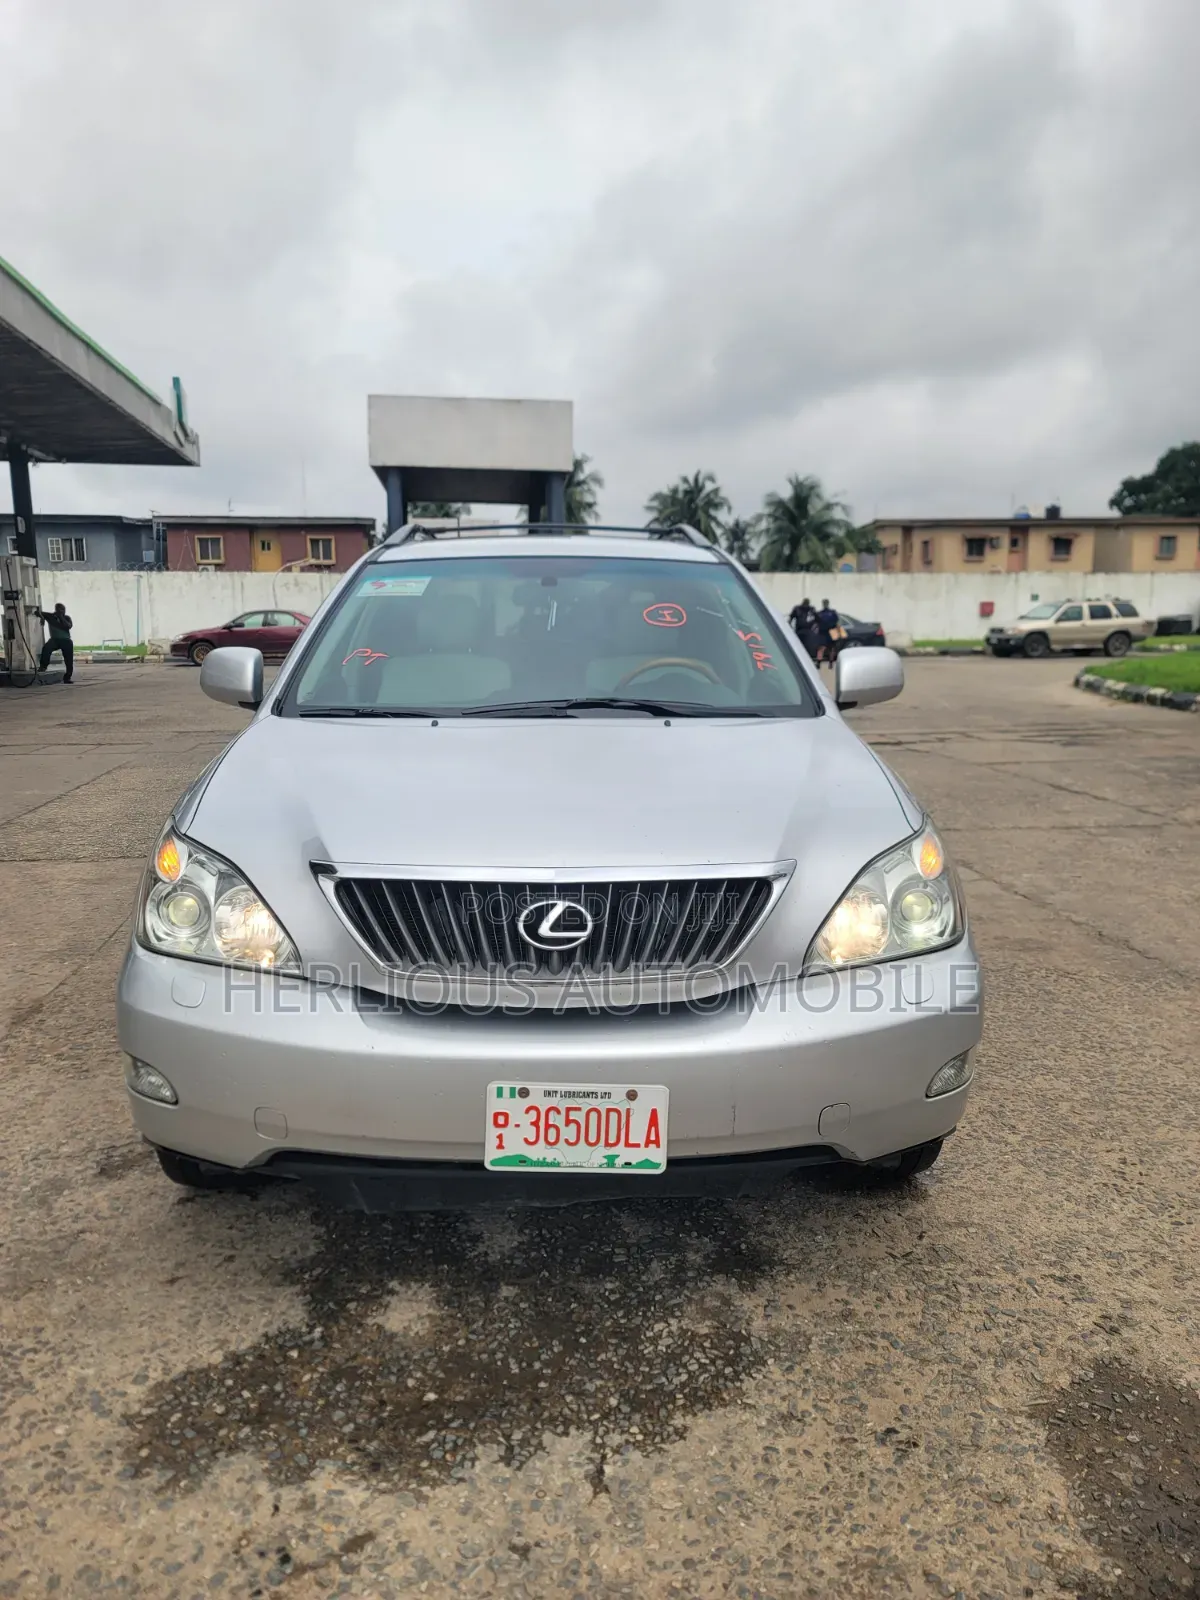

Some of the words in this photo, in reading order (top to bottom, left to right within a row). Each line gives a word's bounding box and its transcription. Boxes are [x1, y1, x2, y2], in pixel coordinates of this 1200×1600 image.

[543, 1089, 559, 1098] UNIT
[559, 1090, 599, 1100] LUBRICANTS
[600, 1091, 612, 1100] LTD
